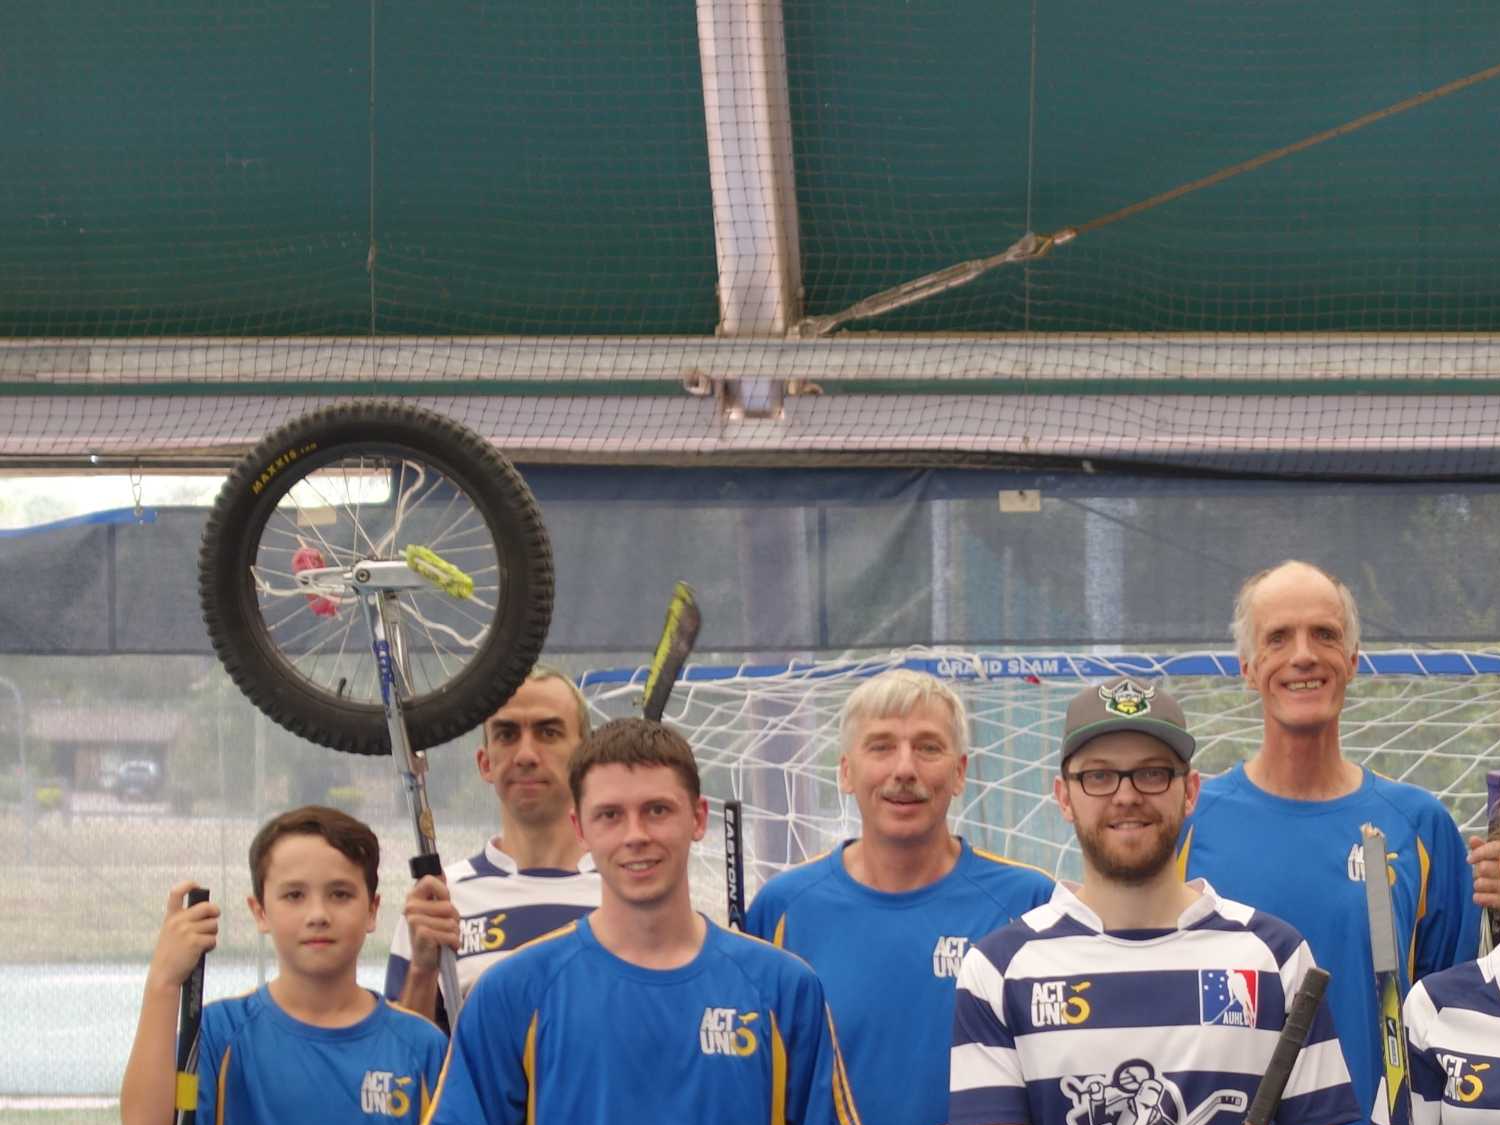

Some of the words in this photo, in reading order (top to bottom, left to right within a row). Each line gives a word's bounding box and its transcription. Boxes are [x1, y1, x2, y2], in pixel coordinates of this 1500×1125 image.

[250, 449, 297, 495] MAXXIS
[1008, 659, 1059, 674] SLAM
[726, 808, 738, 901] EASTON
[934, 936, 968, 958] ACT
[1031, 981, 1066, 1004] ACT
[701, 1008, 737, 1032] ACT
[1223, 1011, 1244, 1025] AUHL
[361, 1071, 393, 1092] ACT
